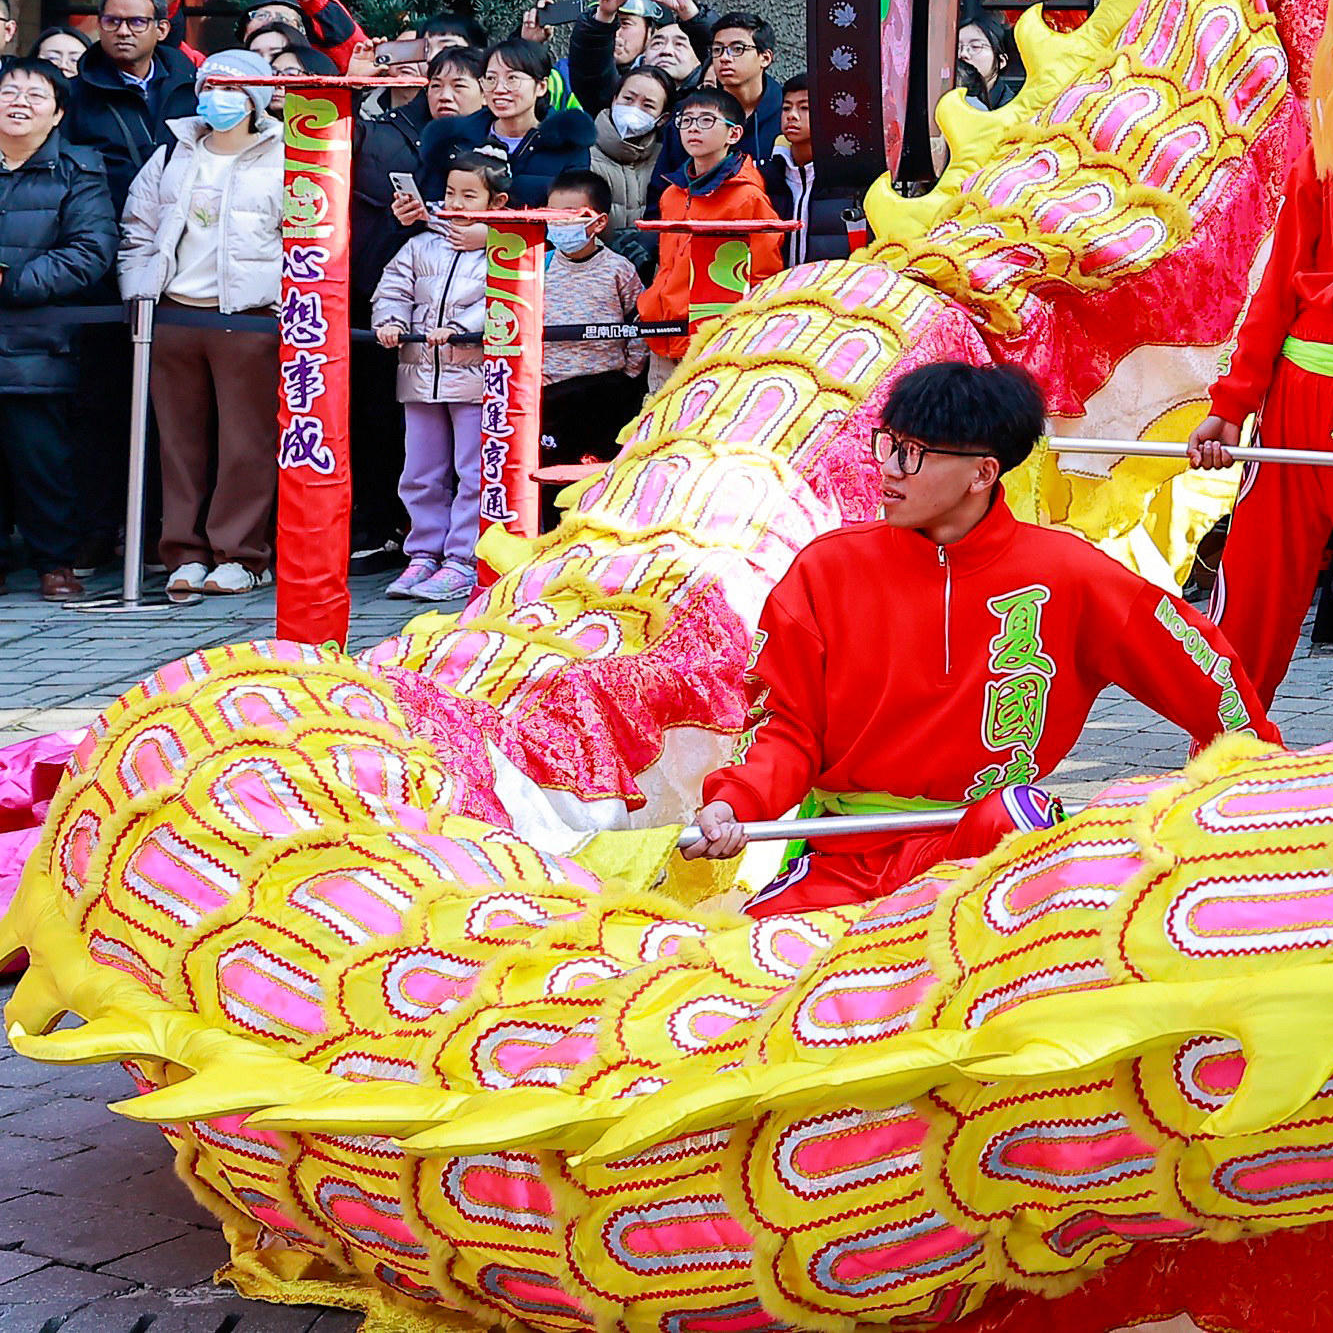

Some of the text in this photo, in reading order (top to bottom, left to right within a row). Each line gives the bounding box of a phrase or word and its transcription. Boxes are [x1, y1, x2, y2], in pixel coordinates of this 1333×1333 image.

[280, 245, 334, 475] 心想事成
[481, 358, 519, 523] 財運亨通
[1154, 594, 1220, 675] MOON
